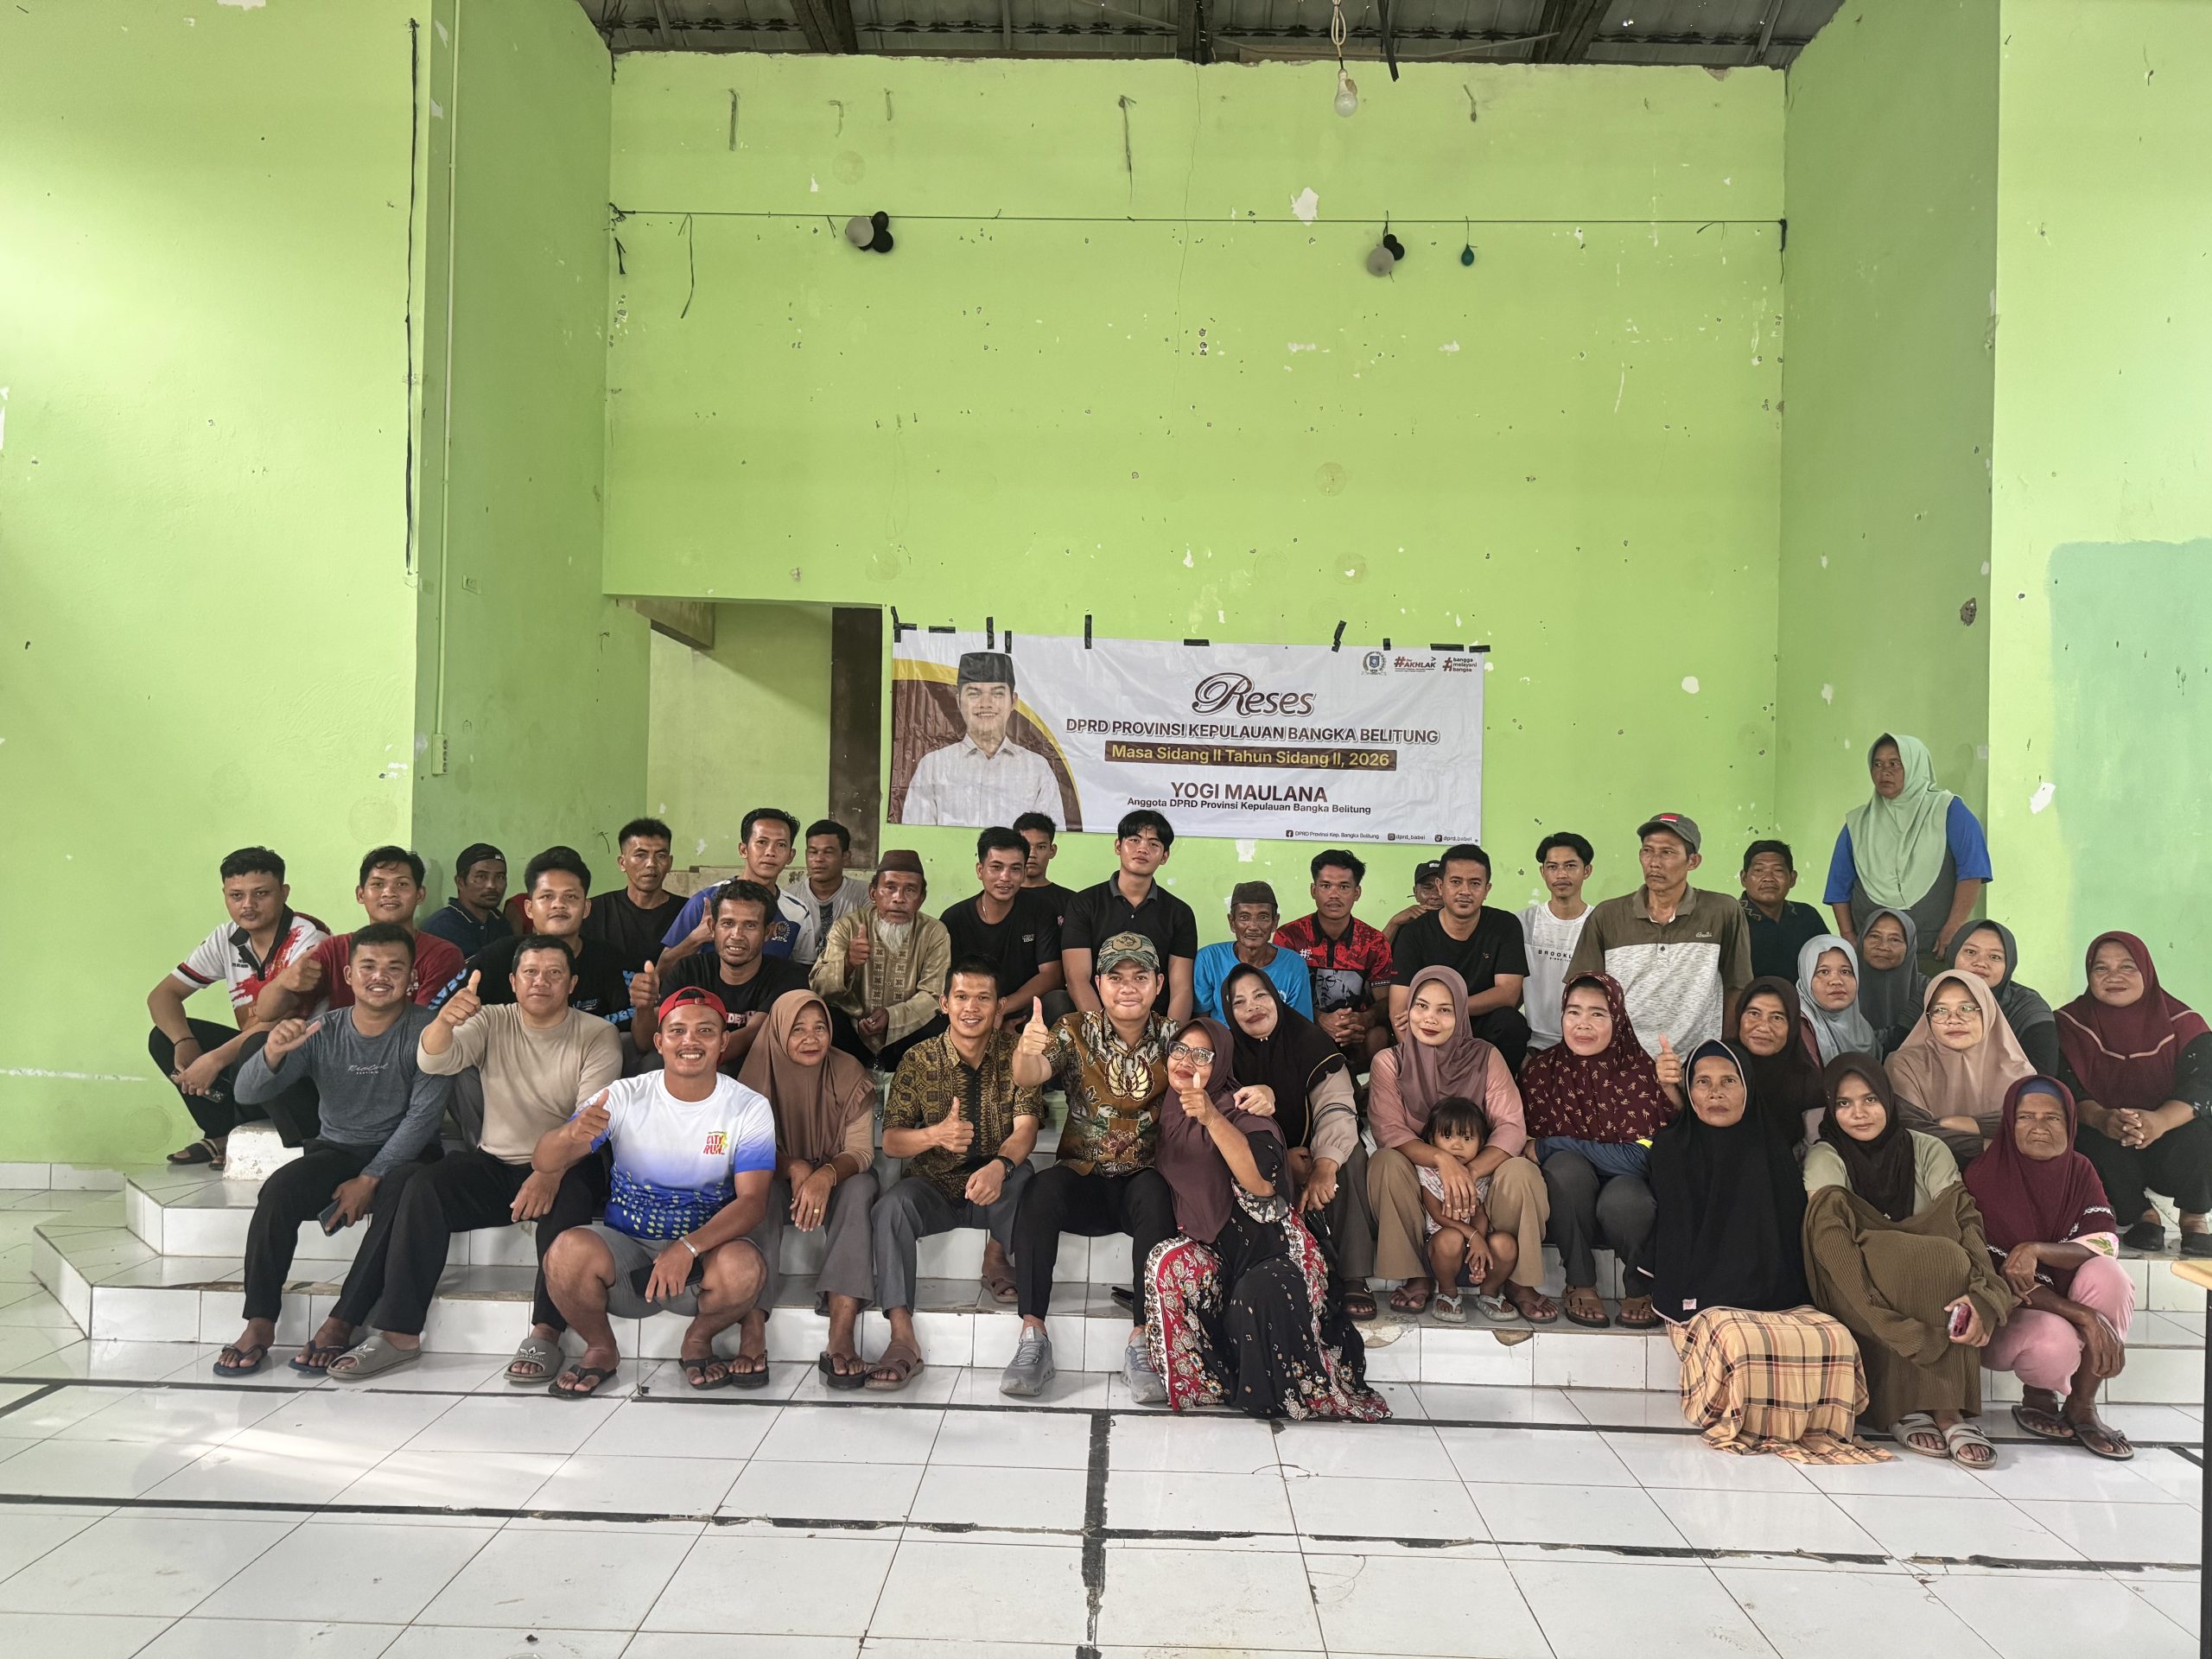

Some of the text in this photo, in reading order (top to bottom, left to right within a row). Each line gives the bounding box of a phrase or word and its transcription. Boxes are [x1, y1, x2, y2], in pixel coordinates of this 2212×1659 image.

[1192, 672, 1314, 716] Reses
[1066, 718, 1440, 743] DPRD PROVINSI KEPULAUAN BANGKA BELITUNG
[1112, 744, 1389, 767] Masa Sidang II Tahun Sidang II, 2026
[1171, 782, 1328, 802] YOGI MAULANA
[1128, 798, 1371, 815] Anggota DPRD Provinsi Kepulauan Bangka Belitung
[1538, 950, 1572, 959] BROOKL
[702, 1144, 723, 1154] RUN
[706, 1135, 724, 1145] CITY
